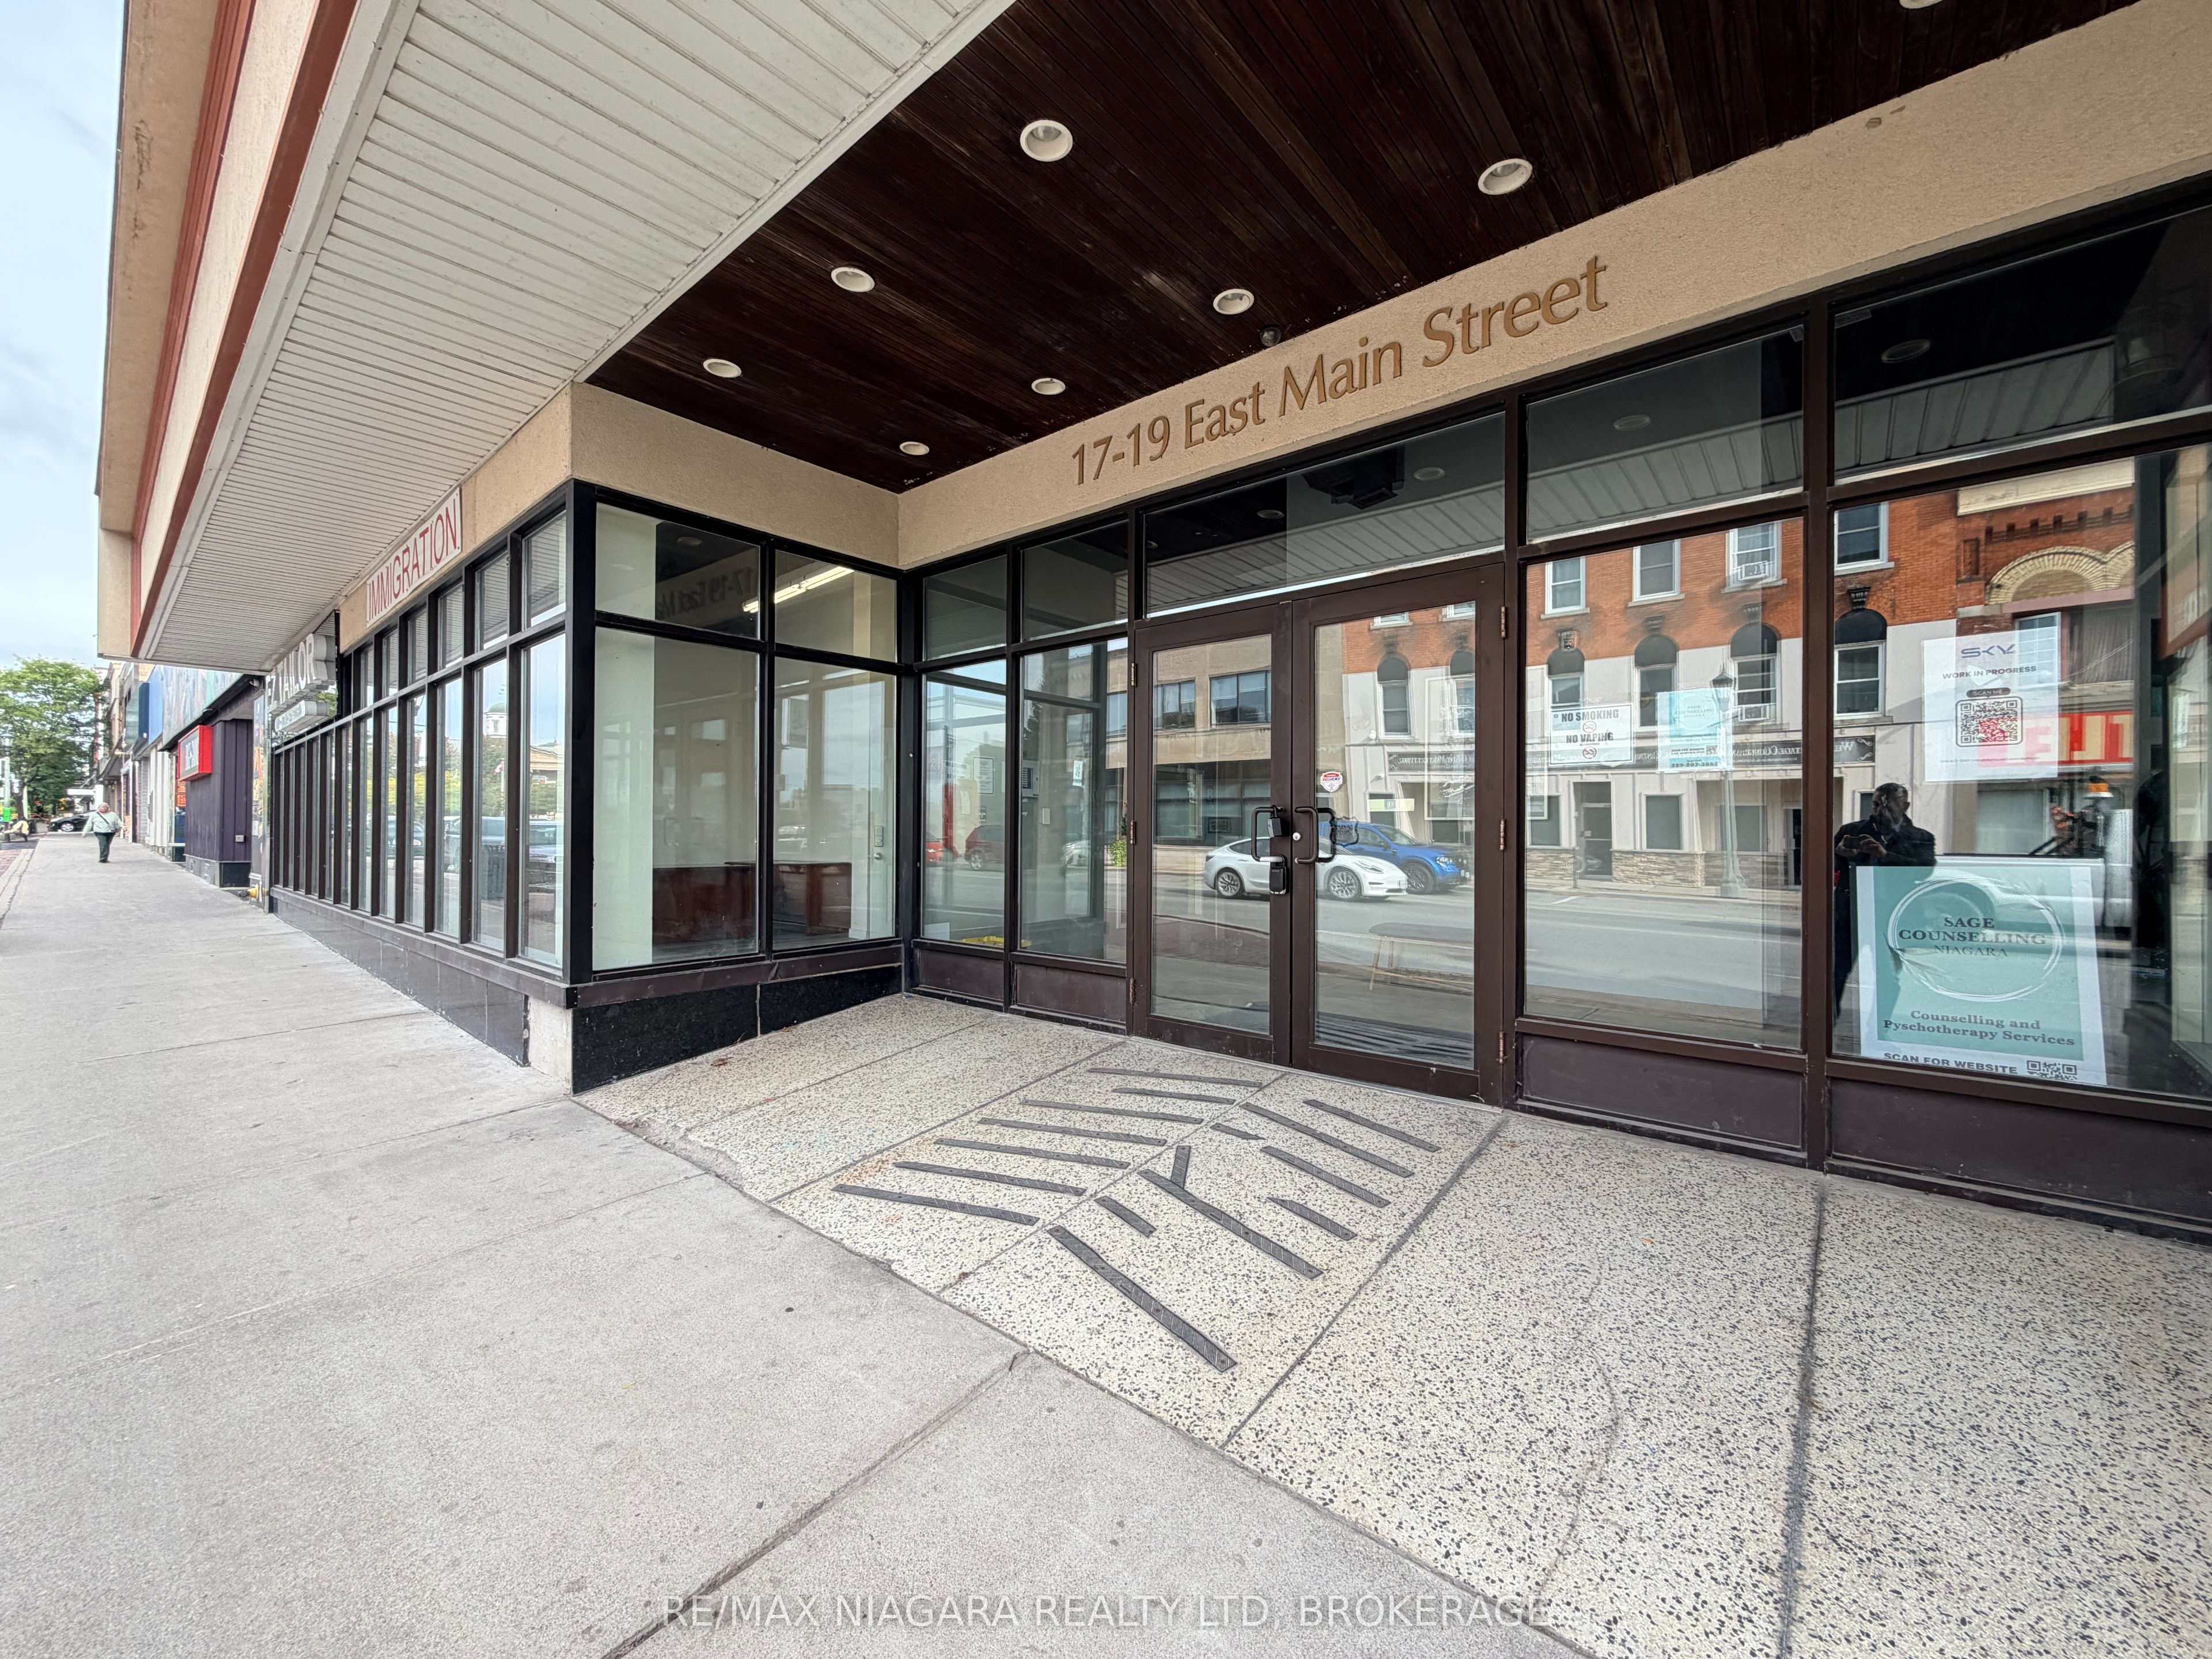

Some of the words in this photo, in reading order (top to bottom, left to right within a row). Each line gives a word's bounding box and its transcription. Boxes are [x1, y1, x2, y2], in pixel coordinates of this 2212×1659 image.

[1072, 415, 1170, 484] 17-19
[1184, 381, 1266, 449] East
[1279, 336, 1402, 416] Main
[1422, 256, 1607, 368] Street
[369, 498, 457, 622] IMMIGRATION
[1961, 644, 2016, 658] SKY
[1942, 671, 1971, 679] WORK
[1986, 666, 2037, 676] PROGRESS
[1561, 713, 1573, 722] NO
[1575, 709, 1619, 721] SMOKING
[1566, 734, 1578, 743] NO
[1580, 732, 1614, 743] VAPING
[1944, 917, 1995, 929] SAGE
[1899, 929, 2047, 945] COUNSELLING
[1934, 945, 2009, 957] NIAGARA
[1910, 1010, 2006, 1028] Counselling
[2010, 1020, 2041, 1030] and
[1883, 1020, 2002, 1040] Pyschotherapy
[2003, 1030, 2075, 1046] Services
[1883, 1052, 1919, 1063] SCAN
[1923, 1056, 1950, 1066] FOR
[1955, 1060, 2018, 1075] WEBSITE
